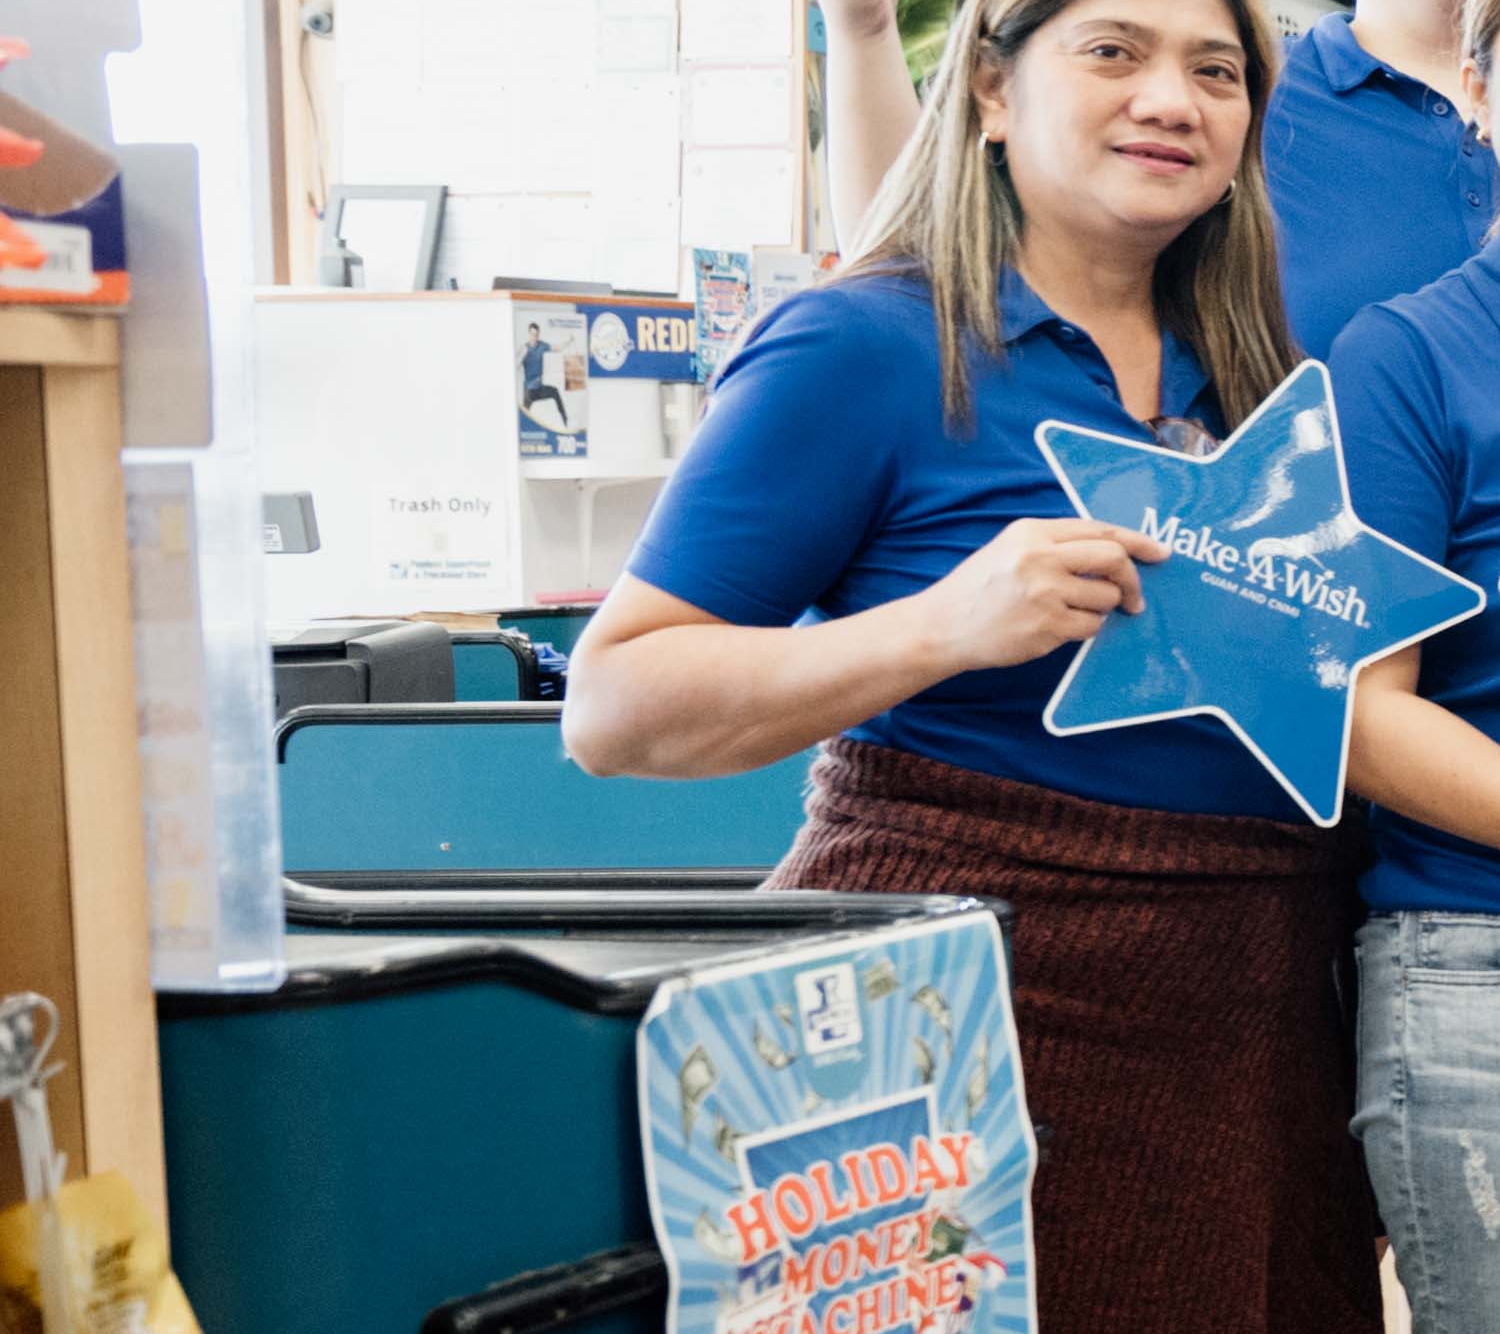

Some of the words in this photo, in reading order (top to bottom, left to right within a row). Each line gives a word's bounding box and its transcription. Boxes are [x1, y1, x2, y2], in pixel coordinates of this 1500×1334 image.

[389, 497, 442, 512] Trash
[448, 497, 491, 518] Only
[1139, 507, 1372, 629] Make-A-Wish
[1238, 585, 1267, 605] AND
[728, 1133, 976, 1263] HOLIDAY
[780, 1210, 940, 1302] MONEY
